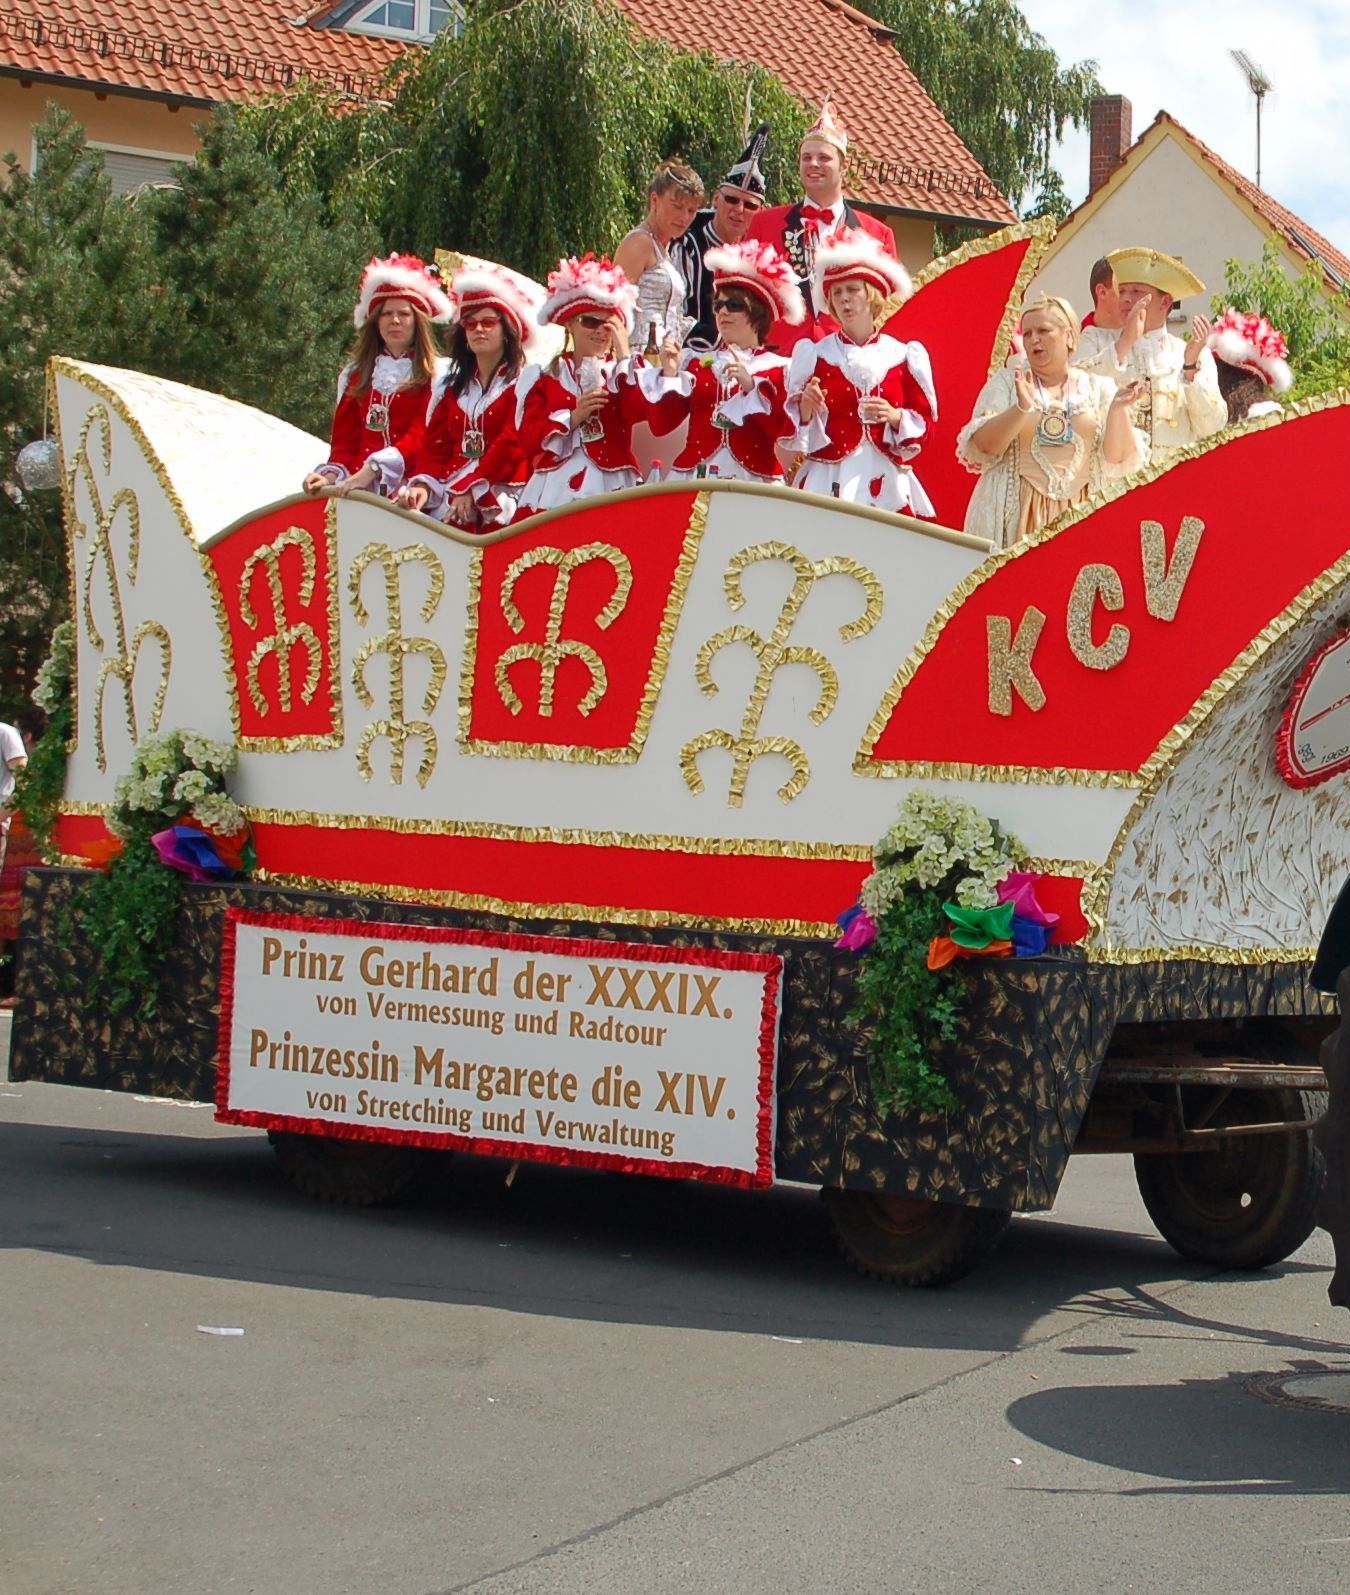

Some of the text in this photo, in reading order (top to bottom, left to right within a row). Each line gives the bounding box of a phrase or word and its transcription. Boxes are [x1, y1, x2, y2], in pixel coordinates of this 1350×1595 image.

[986, 515, 1205, 716] KCV
[262, 936, 733, 1019] Prinz Gerhard der XXXIX.
[316, 991, 667, 1047] von Vermessung und Radtour
[250, 1028, 736, 1120] Prinzessin Margarete die XIV.
[306, 1089, 676, 1157] von Stretching und Verwaltung
